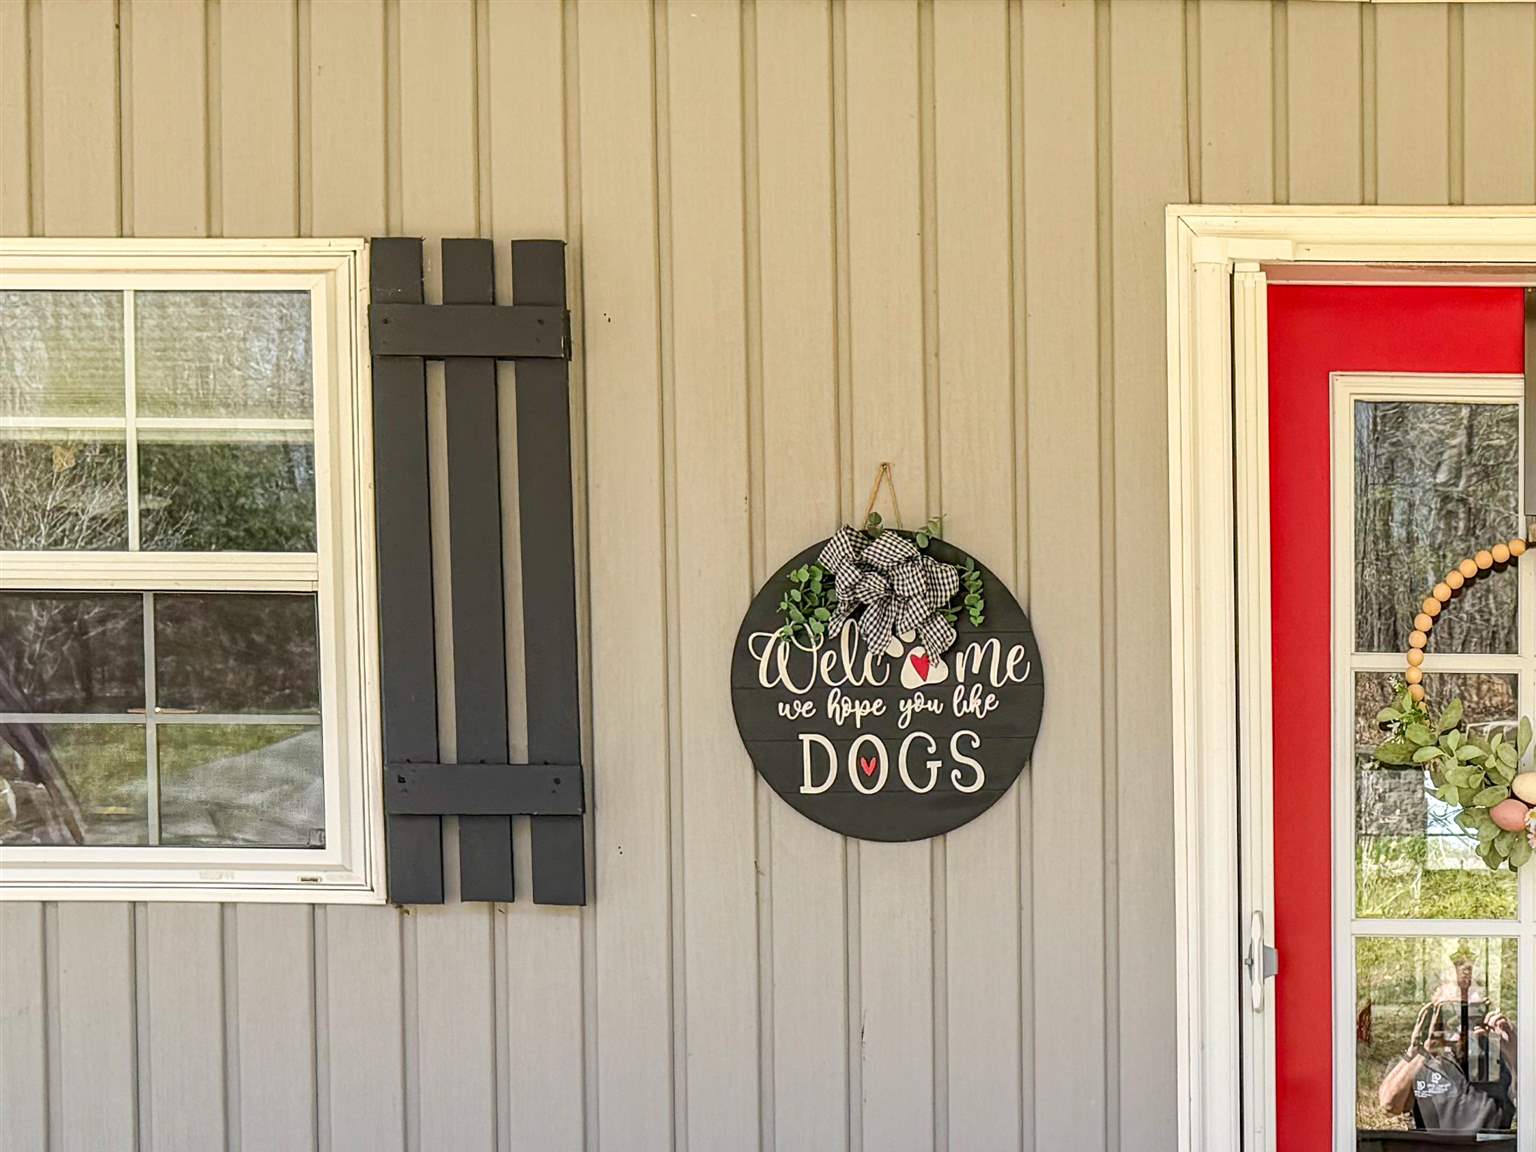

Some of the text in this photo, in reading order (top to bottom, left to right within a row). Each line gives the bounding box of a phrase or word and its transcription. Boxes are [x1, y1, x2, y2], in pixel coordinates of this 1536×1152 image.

[777, 683, 1000, 729] we hope you like
[798, 729, 985, 795] DOGS
